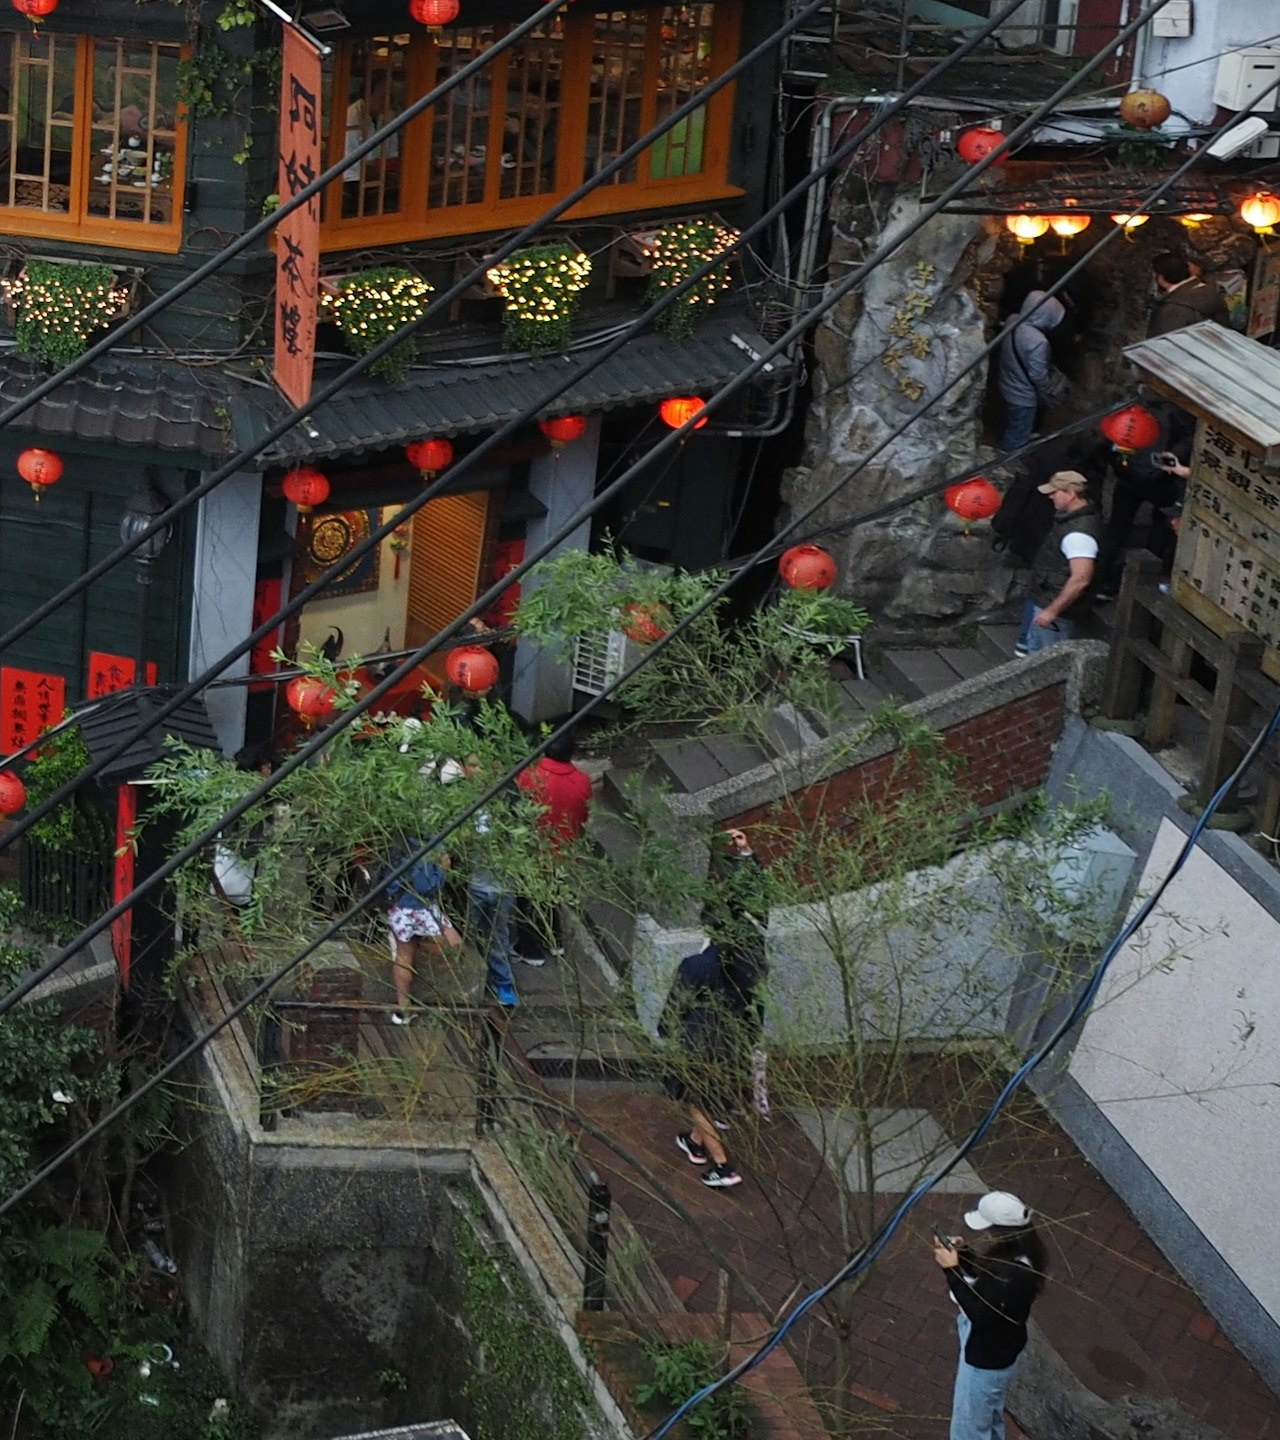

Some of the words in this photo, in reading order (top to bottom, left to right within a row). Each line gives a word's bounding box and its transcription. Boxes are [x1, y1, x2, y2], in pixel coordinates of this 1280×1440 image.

[280, 73, 317, 357] 阿妹茶樓
[1204, 425, 1280, 485] 海悅
